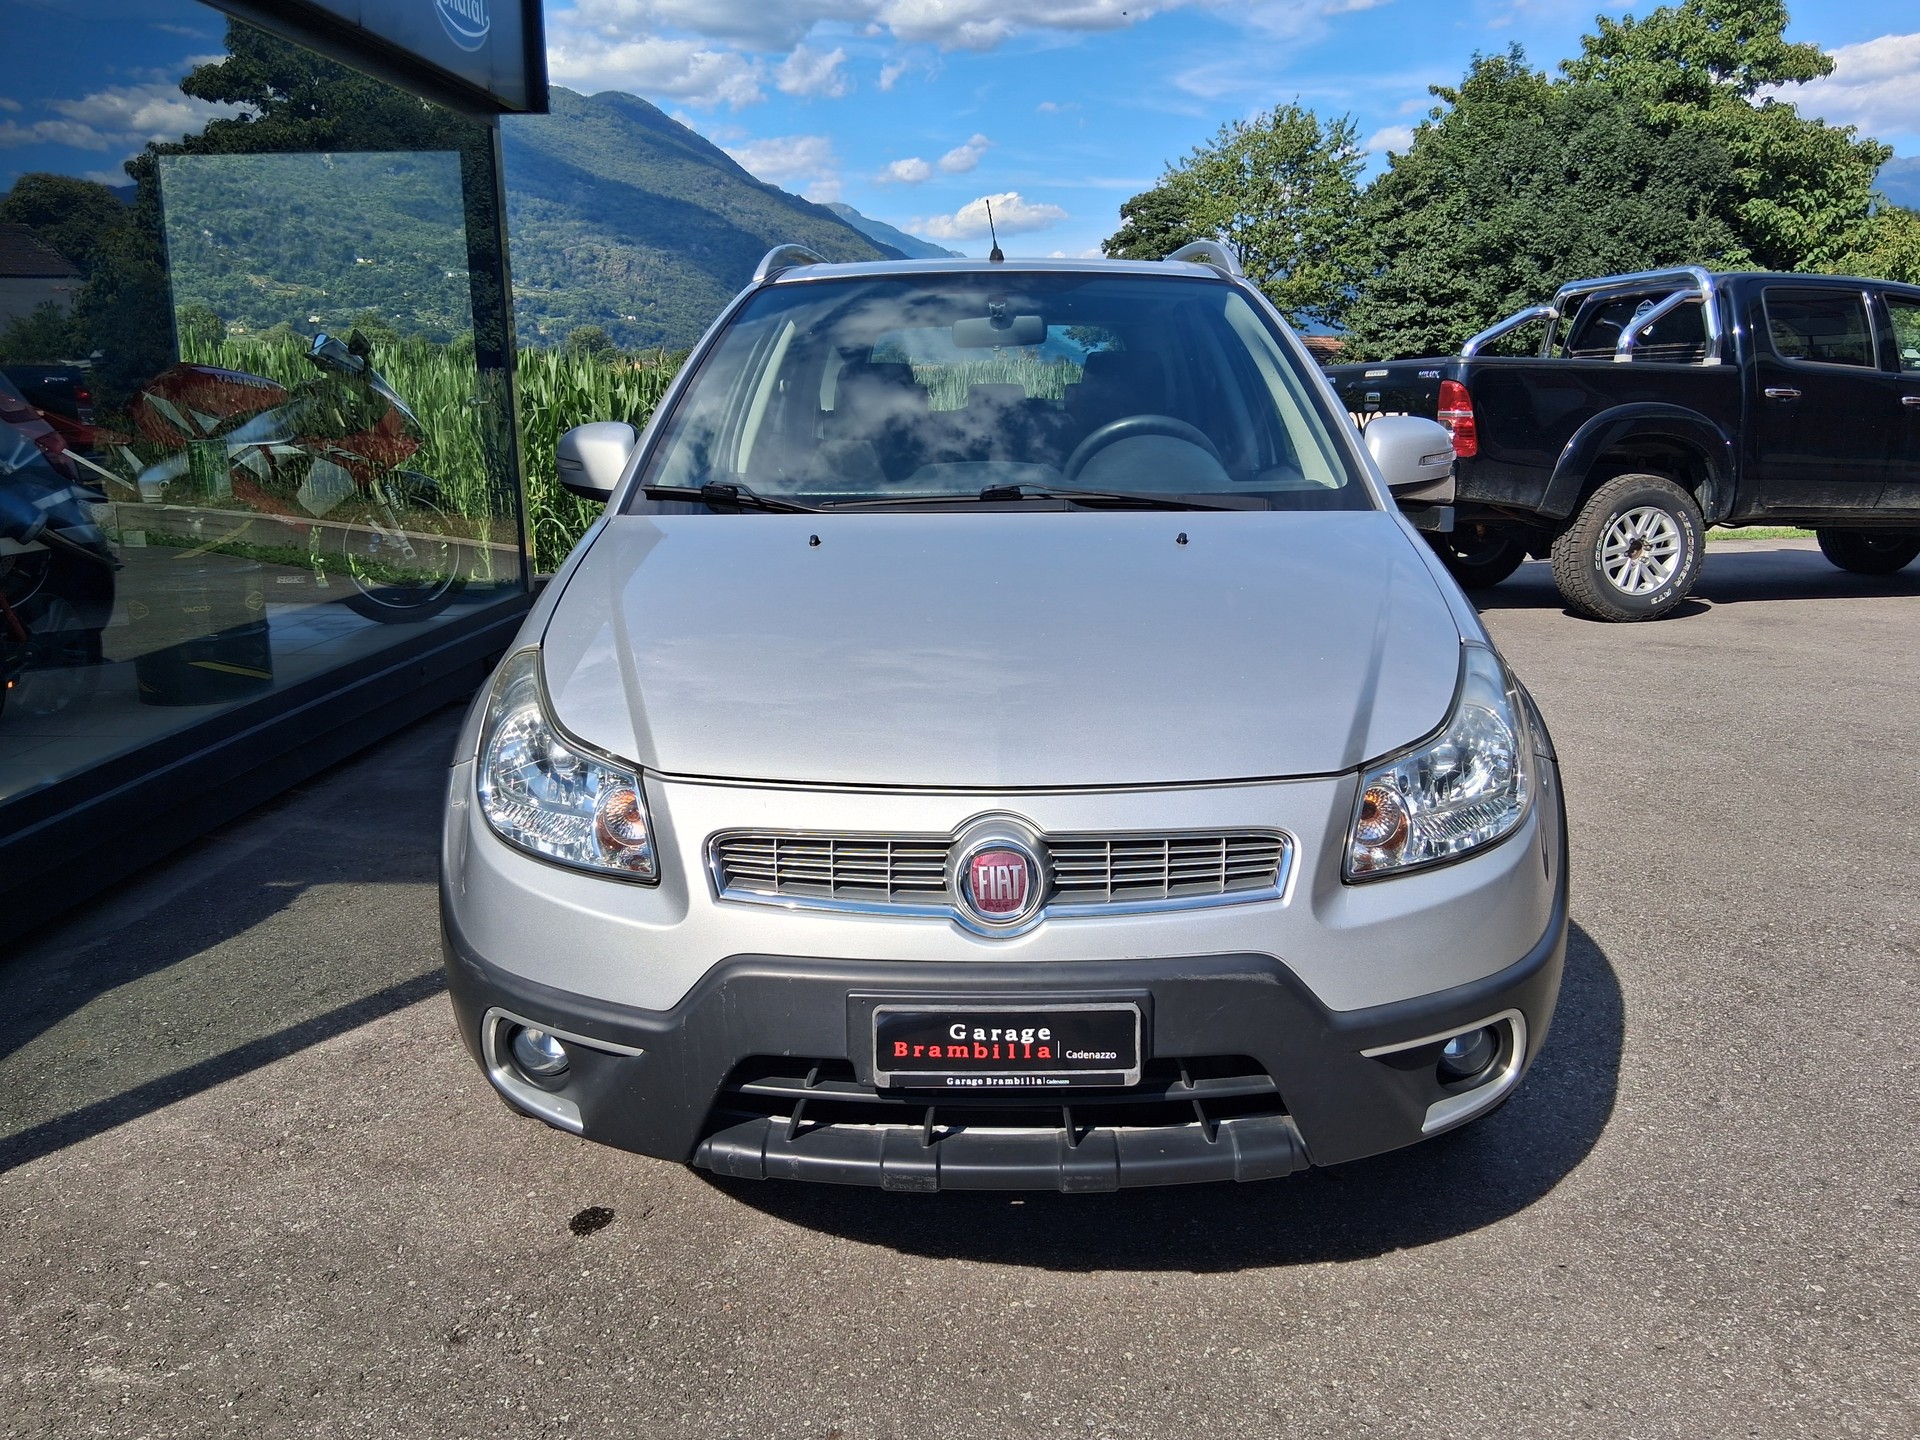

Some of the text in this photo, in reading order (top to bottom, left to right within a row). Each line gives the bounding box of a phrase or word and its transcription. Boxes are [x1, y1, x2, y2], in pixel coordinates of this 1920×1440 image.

[214, 373, 270, 391] YAMAHA
[182, 605, 211, 613] YACCO
[977, 864, 1023, 901] FIAT
[949, 1023, 1051, 1044] Garage
[893, 1041, 1117, 1060] Brambilla Cadenazzo
[946, 1076, 983, 1086] Garage
[986, 1076, 1043, 1085] Brambilla
